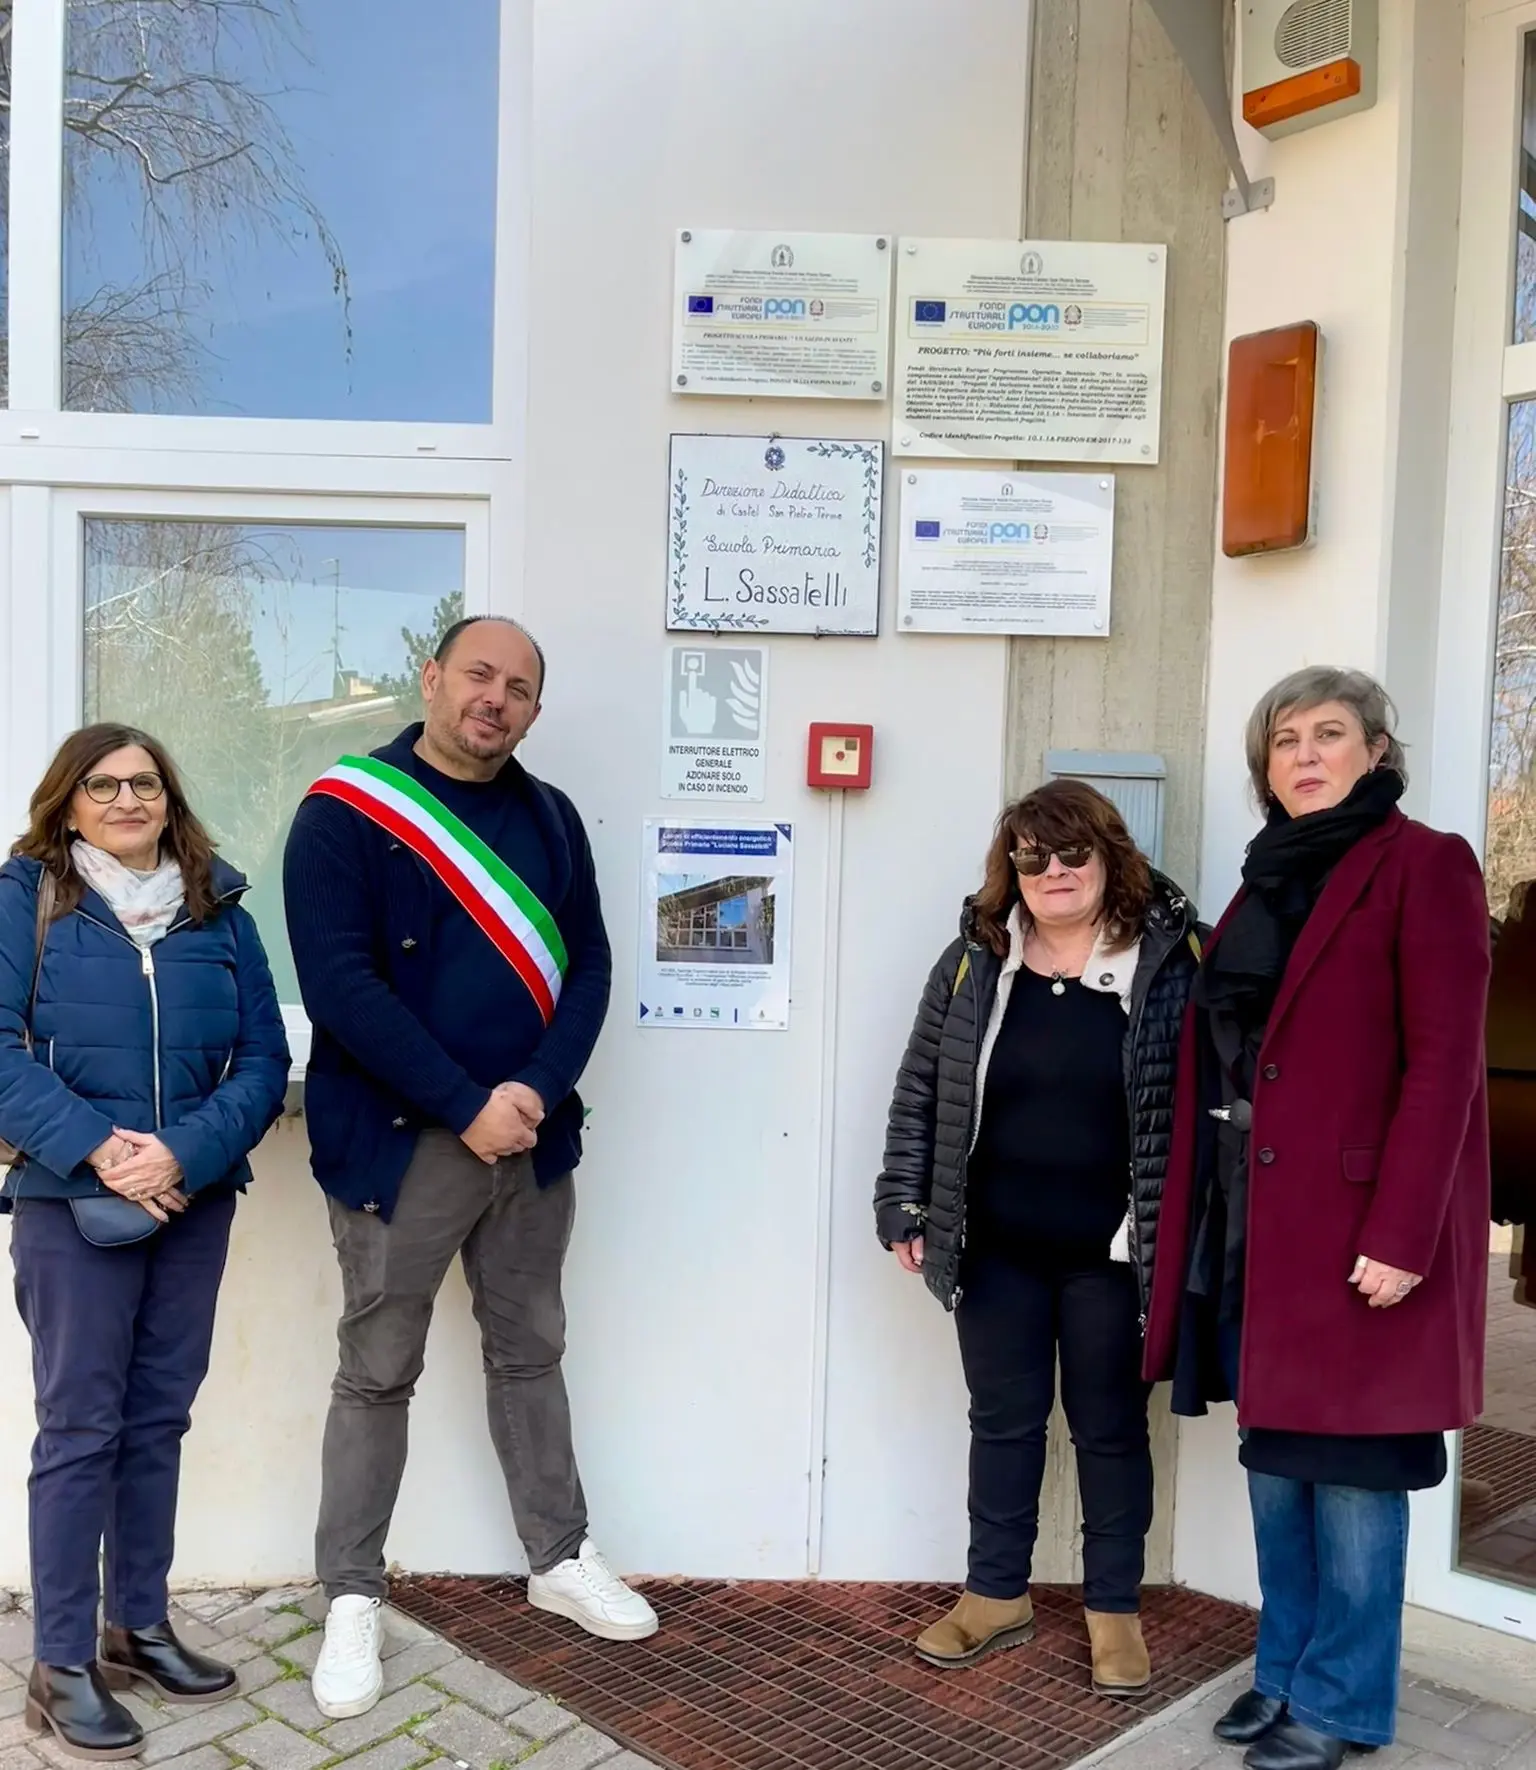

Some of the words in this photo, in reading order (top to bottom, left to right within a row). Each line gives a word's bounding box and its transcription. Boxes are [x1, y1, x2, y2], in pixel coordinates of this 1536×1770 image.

[716, 304, 762, 312] STRUTTURALI
[764, 298, 806, 320] pon
[979, 302, 1006, 311] FONDI
[949, 311, 1006, 320] STRUTTURALI
[1008, 303, 1060, 330] pon
[968, 321, 1006, 330] EUROPEI
[918, 346, 971, 356] PROGETTO:
[973, 348, 992, 358] "Più
[994, 348, 1015, 359] forti
[1018, 349, 1060, 359] insieme...
[1075, 351, 1140, 361] collaboriamo"
[700, 478, 766, 498] Direzione
[770, 481, 845, 502] Didattica
[717, 507, 726, 517] di
[731, 505, 760, 517] Castel
[768, 505, 784, 518] San
[788, 505, 813, 519] Pietro
[814, 507, 842, 520] Terme
[990, 523, 1030, 544] pon
[703, 534, 757, 554] Scuola
[762, 536, 842, 558] Primaria
[704, 566, 730, 602] L.
[735, 567, 848, 607] Sassatelli
[669, 745, 721, 756] INTERRUTTORE
[722, 747, 760, 757] ELETTRICO
[695, 758, 732, 768] GENERALE
[686, 770, 720, 780] AZIONARE
[722, 772, 741, 781] SOLO
[678, 783, 686, 791] IN
[686, 783, 706, 792] CASO
[707, 784, 714, 792] DI
[716, 784, 749, 793] INCENDIO
